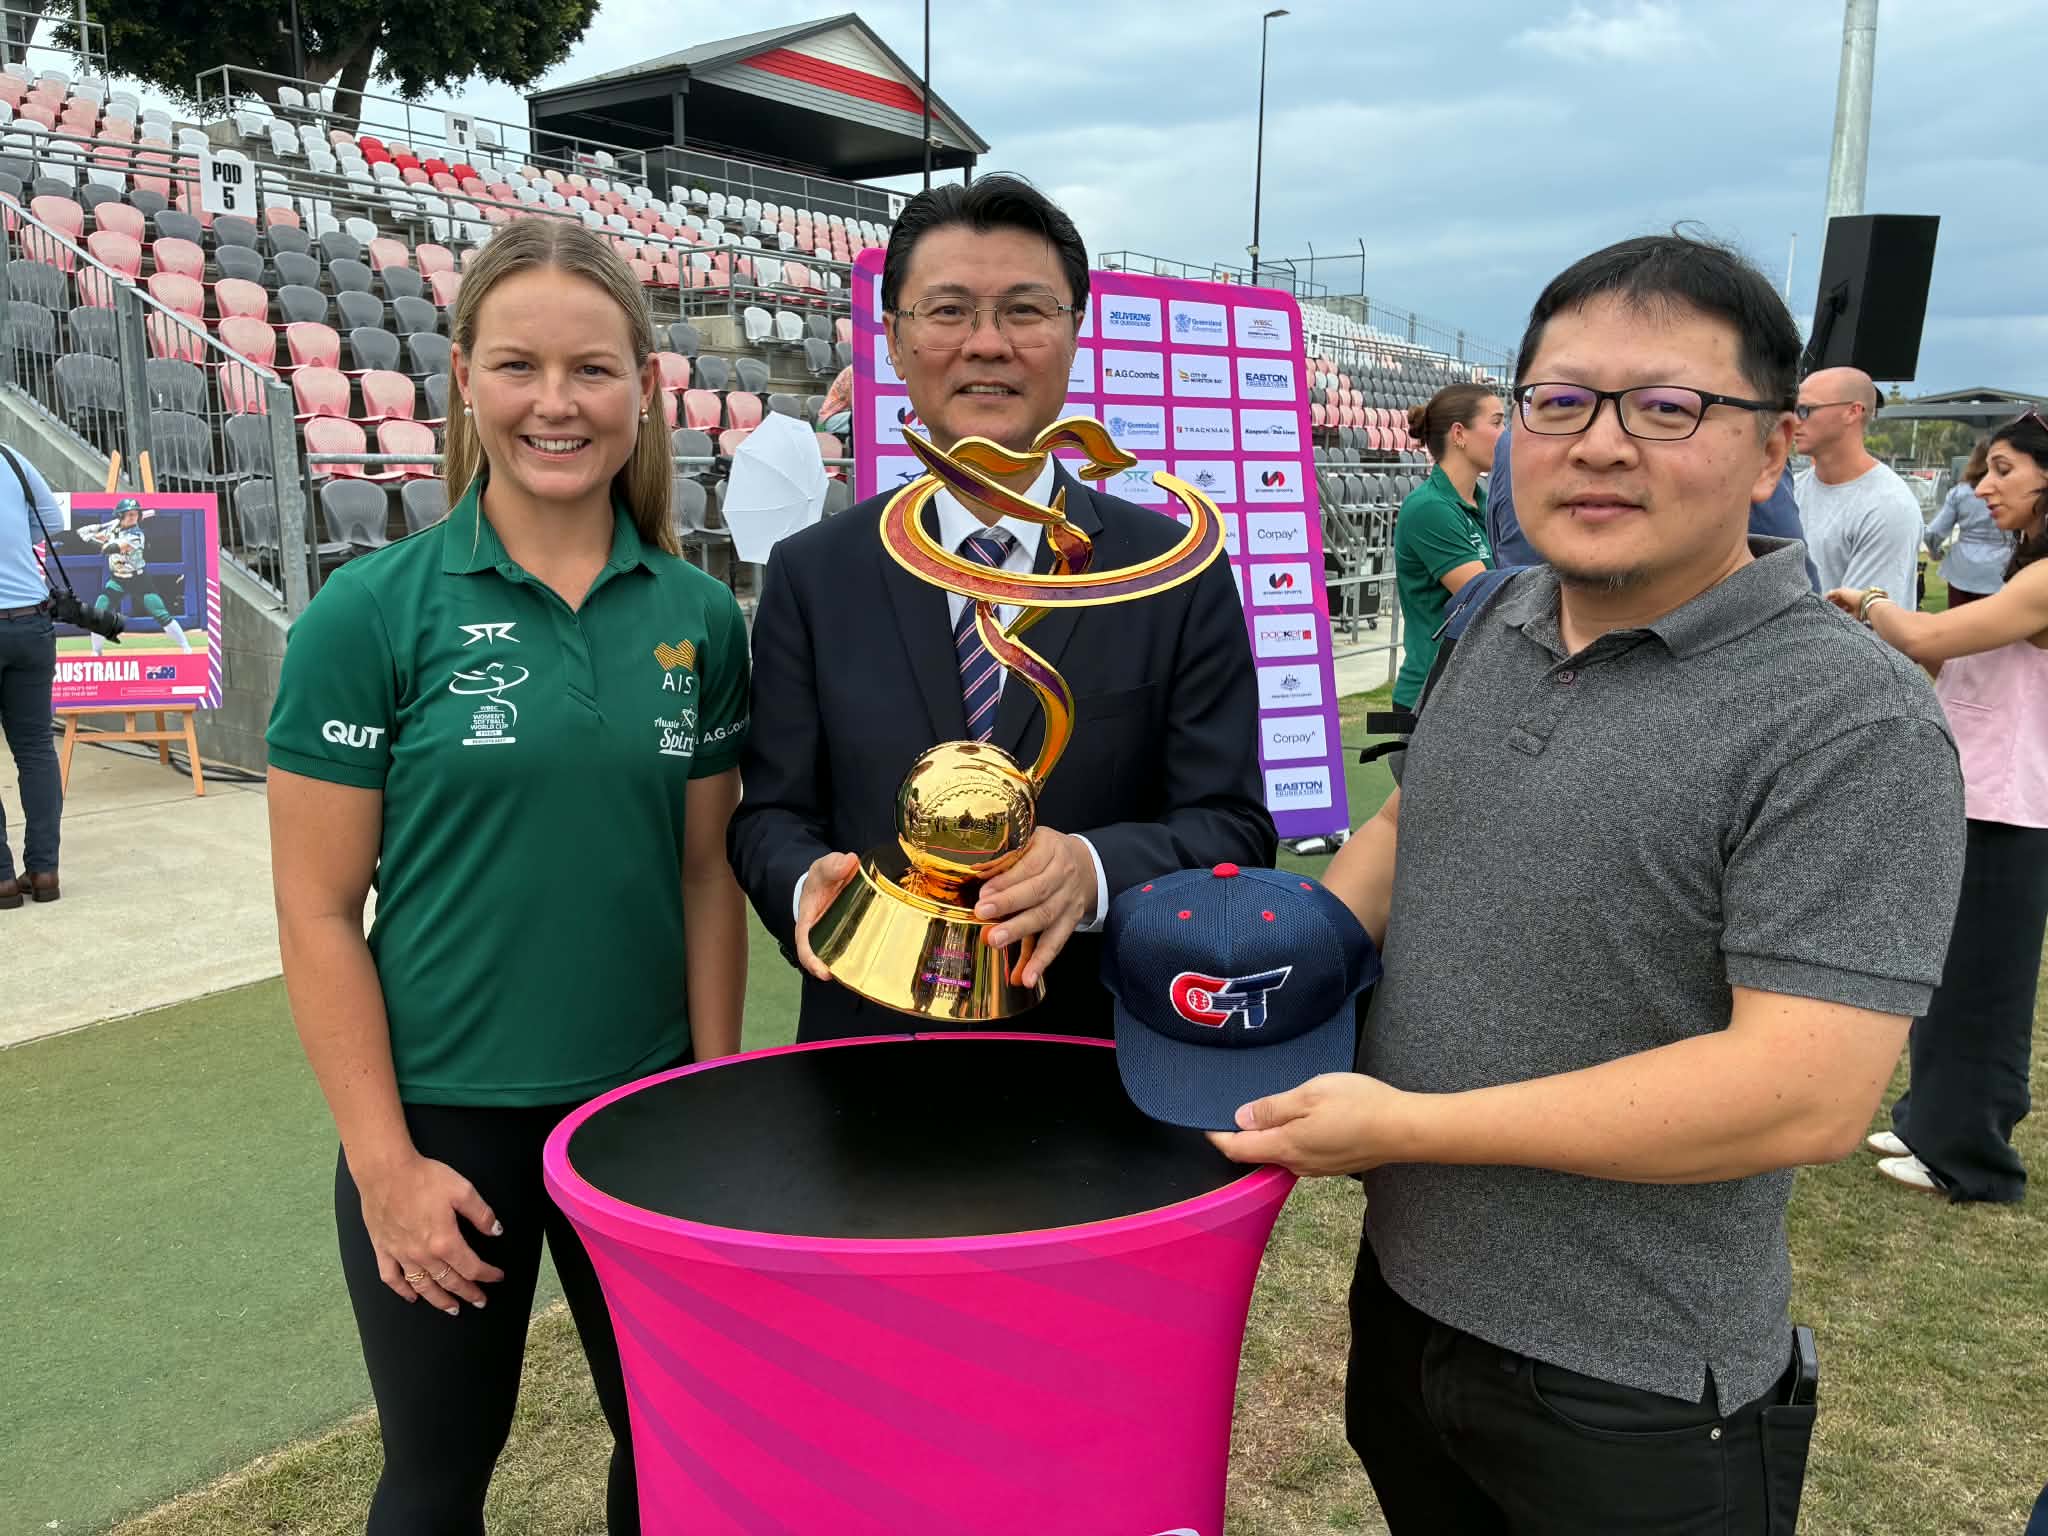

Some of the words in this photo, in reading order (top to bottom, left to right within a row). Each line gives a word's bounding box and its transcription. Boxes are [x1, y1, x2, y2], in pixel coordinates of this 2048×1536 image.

[212, 161, 242, 184] POD
[223, 186, 235, 210] 5
[1110, 312, 1151, 322] DELIVERING
[1245, 373, 1288, 383] EASTON
[53, 660, 140, 683] AUSTRALIA
[662, 672, 694, 694] AIS
[655, 716, 680, 729] Aussie
[322, 720, 385, 749] QUT
[1275, 780, 1323, 791] EASTON
